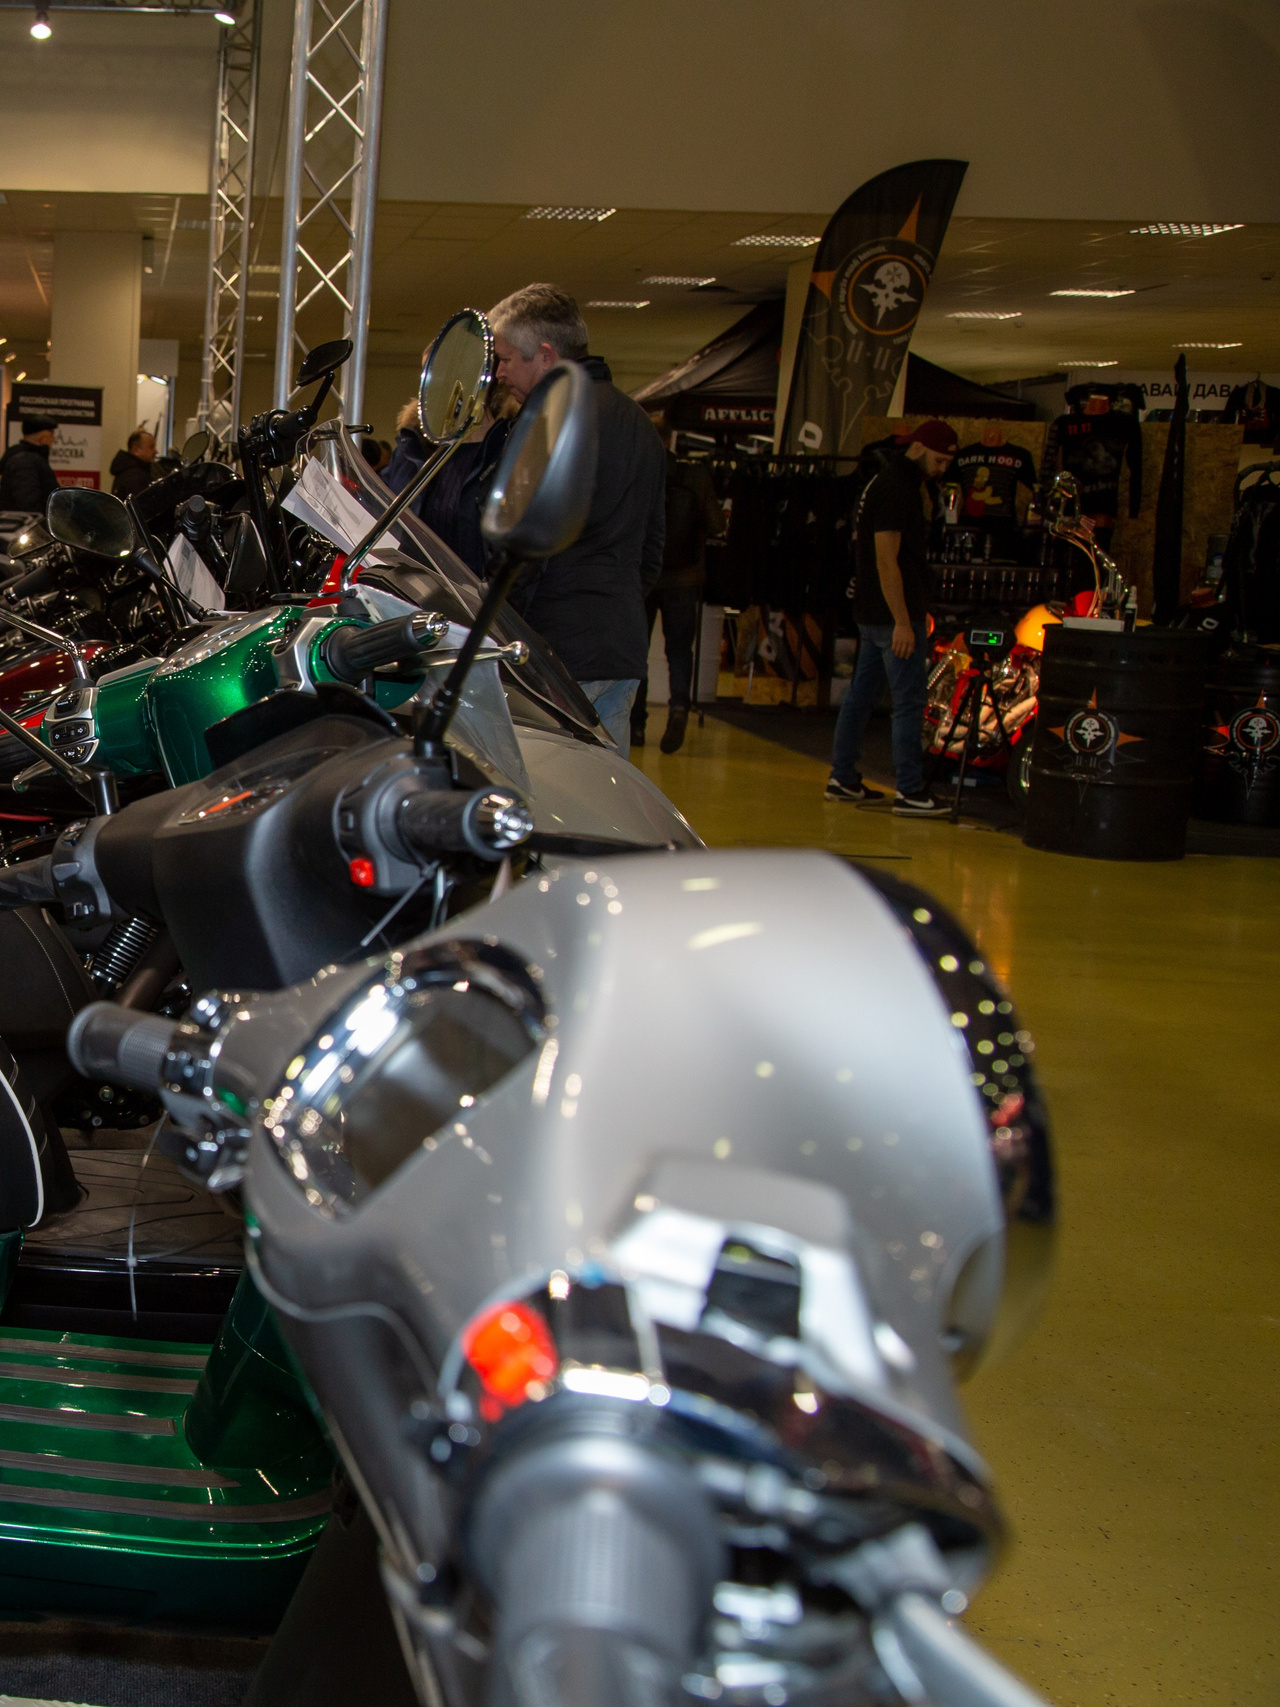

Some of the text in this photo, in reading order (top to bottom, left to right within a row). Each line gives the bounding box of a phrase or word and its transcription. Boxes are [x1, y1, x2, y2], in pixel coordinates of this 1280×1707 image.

[704, 407, 775, 422] AFFLIC
[957, 455, 1023, 468] DARK HOOD
